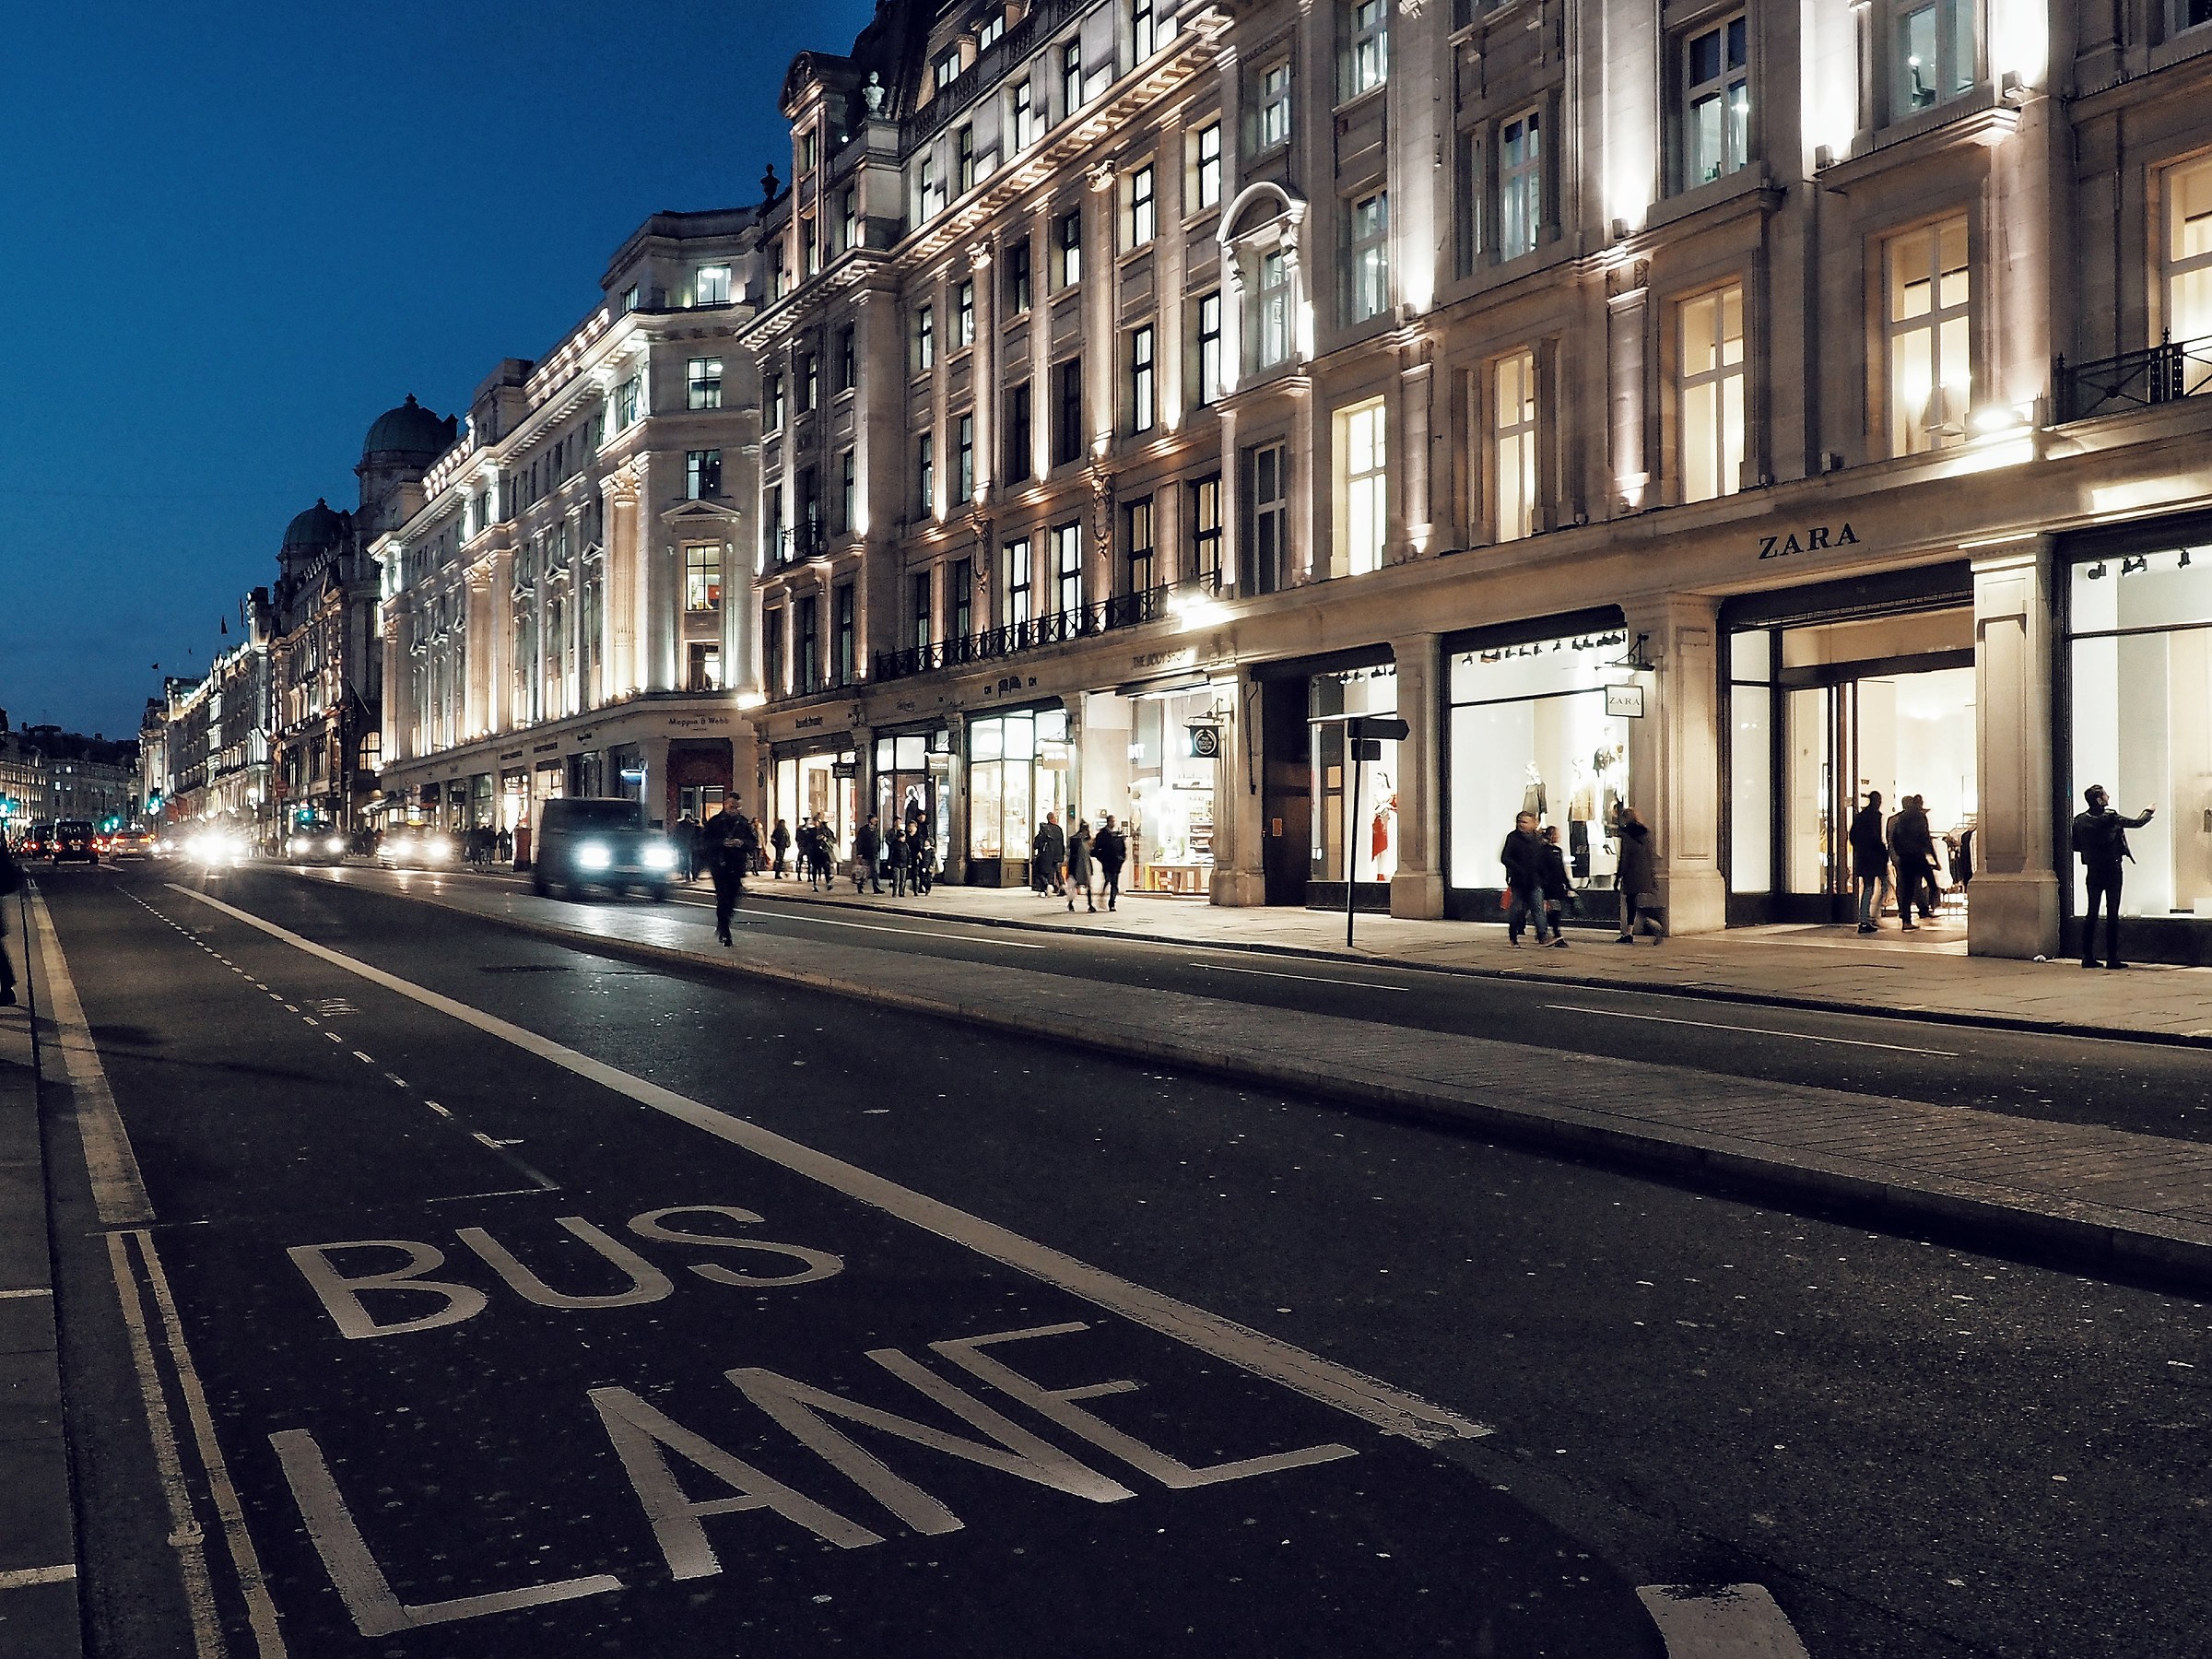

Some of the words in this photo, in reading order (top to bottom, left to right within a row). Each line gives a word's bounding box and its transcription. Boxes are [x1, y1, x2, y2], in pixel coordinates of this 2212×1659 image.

[1759, 523, 1861, 559] ZARA
[1609, 697, 1640, 705] ZARA
[287, 1205, 845, 1339] BUS
[268, 1323, 1359, 1637] LANE
